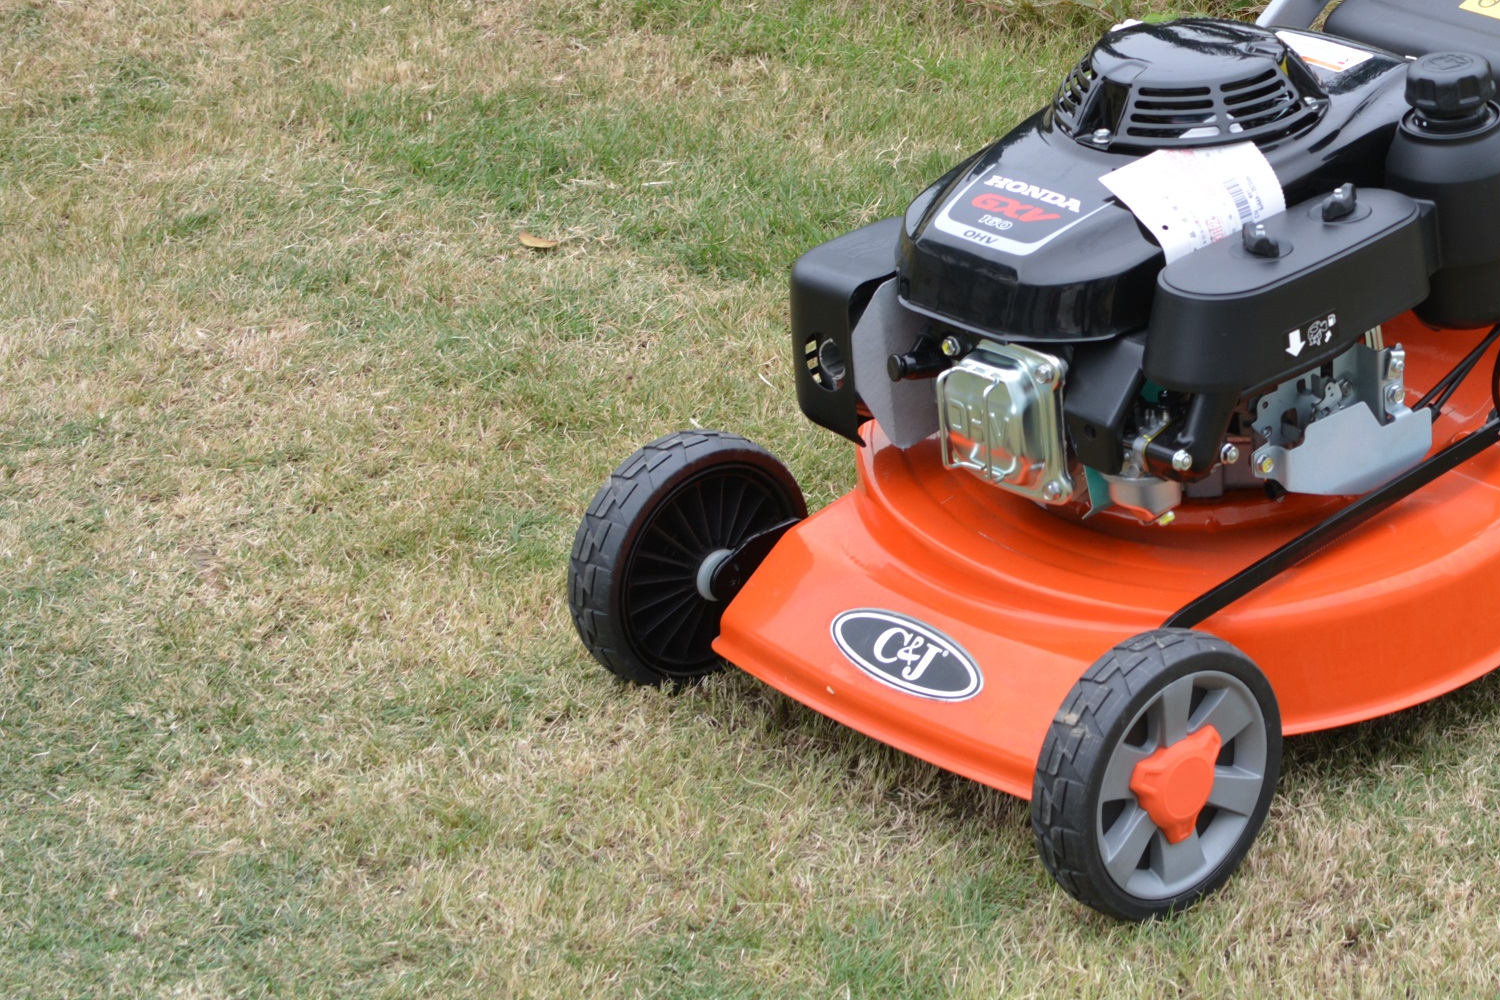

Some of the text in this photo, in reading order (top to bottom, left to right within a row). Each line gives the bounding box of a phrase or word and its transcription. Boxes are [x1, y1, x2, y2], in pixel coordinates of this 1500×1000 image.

[971, 193, 1061, 222] GXV
[984, 175, 1081, 213] HONDA
[978, 214, 1013, 230] 160
[963, 230, 999, 244] OHV
[873, 627, 943, 681] C&J
